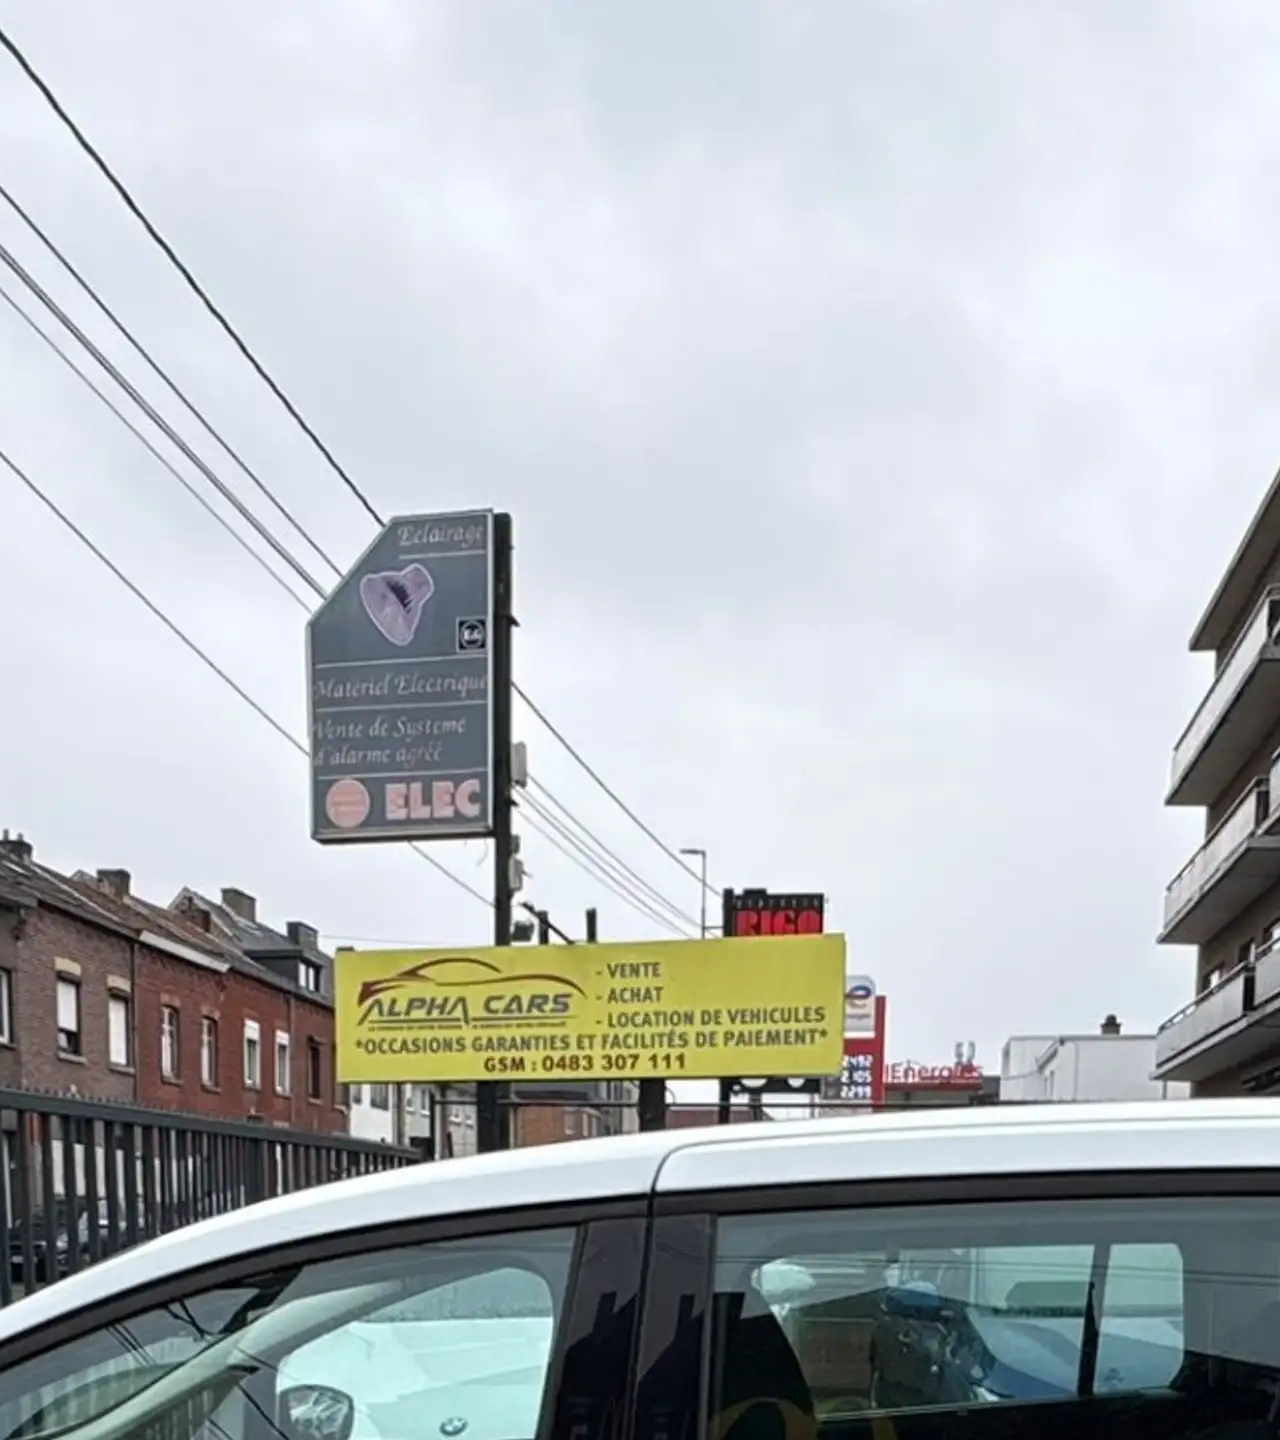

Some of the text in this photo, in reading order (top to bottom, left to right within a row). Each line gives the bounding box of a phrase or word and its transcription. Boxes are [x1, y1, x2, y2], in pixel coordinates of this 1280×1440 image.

[313, 718, 363, 740] Vente
[369, 715, 389, 738] de
[385, 778, 481, 821] ELEC
[607, 962, 661, 979] VENTE
[607, 986, 663, 1004] ACHAT
[357, 993, 573, 1026] ALPHA CARS
[607, 1009, 694, 1028] LOCATION
[701, 1009, 722, 1026] DE
[728, 1006, 826, 1025] VEHICULES
[472, 1033, 570, 1053] GARANTIES
[576, 1034, 597, 1051] ET
[601, 1029, 689, 1050] FACILITÉS
[695, 1030, 718, 1049] DE
[483, 1056, 525, 1073] GSM
[541, 1055, 593, 1072] 0483
[601, 1053, 640, 1071] 307
[648, 1053, 685, 1070] 111
